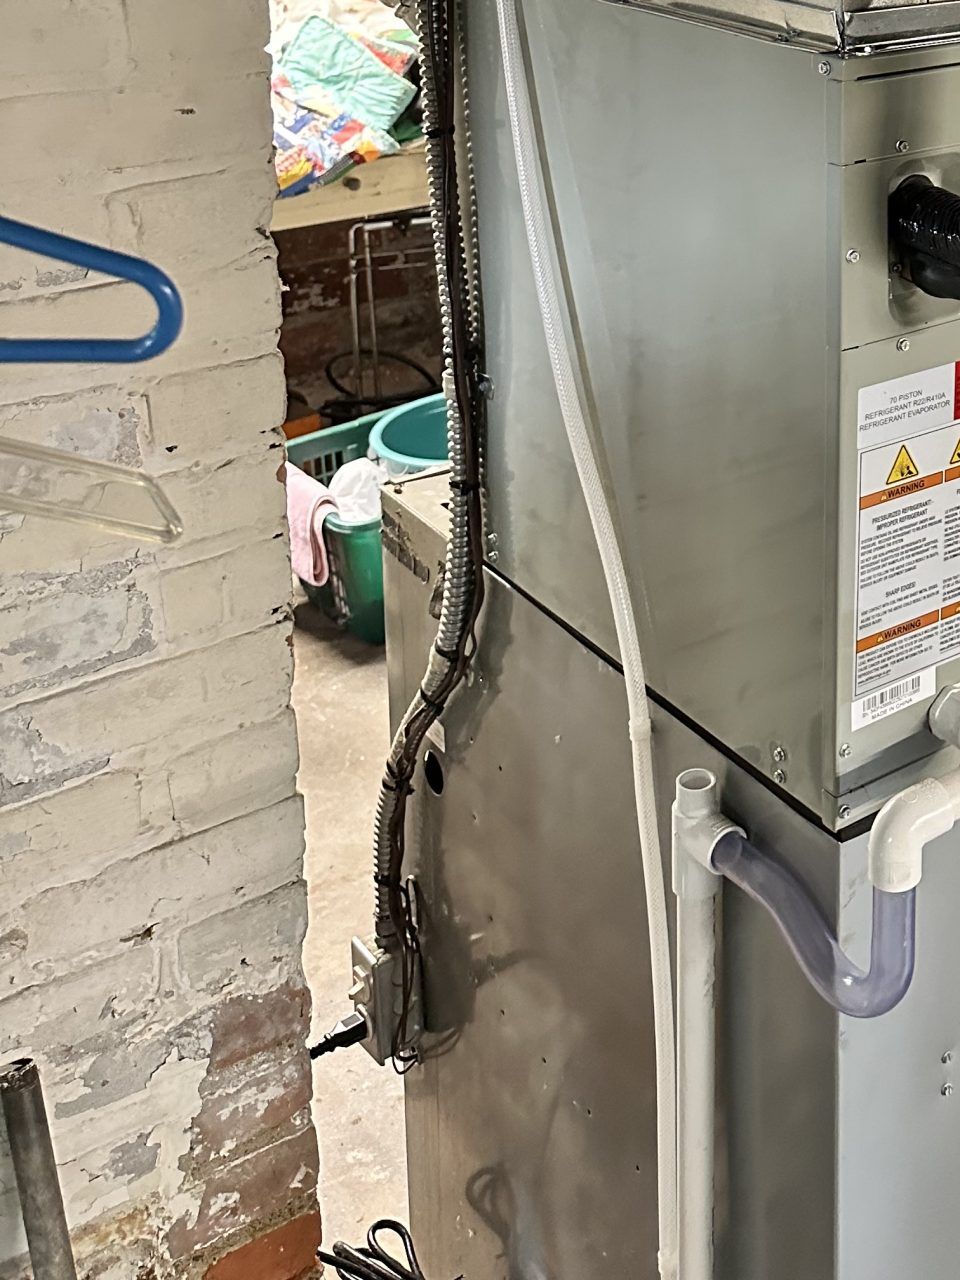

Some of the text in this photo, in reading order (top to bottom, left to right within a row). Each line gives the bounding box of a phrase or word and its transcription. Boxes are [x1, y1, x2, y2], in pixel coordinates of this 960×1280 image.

[898, 390, 923, 401] PISTON
[859, 400, 950, 432] REFRIGERANT EVAPORATOR
[865, 392, 946, 421] REFRIGERANT R22/R410A
[888, 480, 925, 498] WARNING
[884, 620, 921, 639] WARNING
[871, 709, 888, 720] MADE
[895, 697, 913, 709] CHINA
